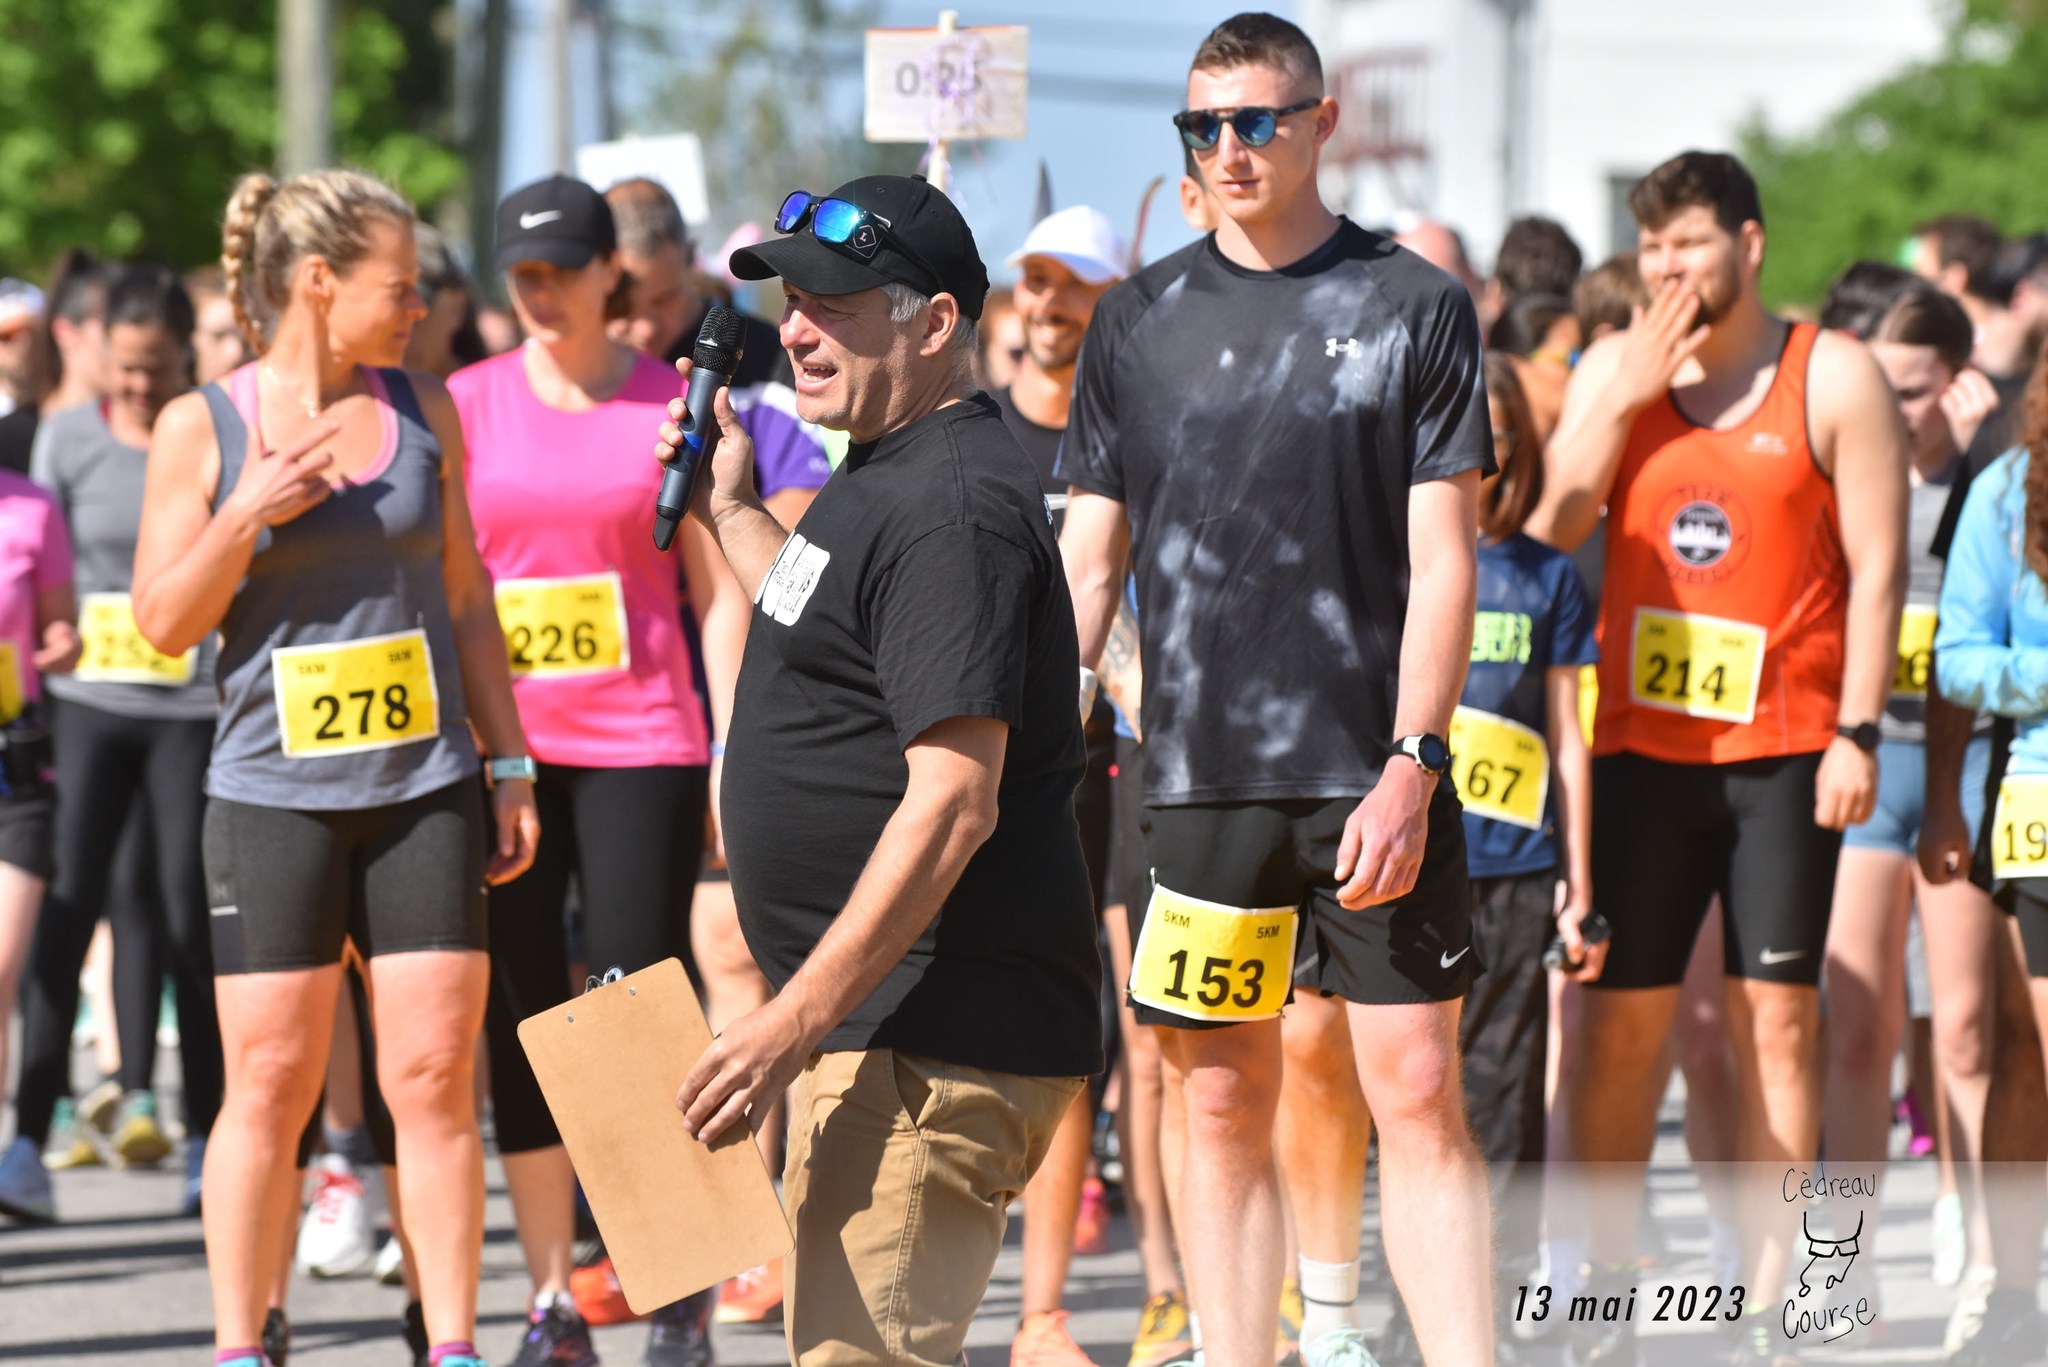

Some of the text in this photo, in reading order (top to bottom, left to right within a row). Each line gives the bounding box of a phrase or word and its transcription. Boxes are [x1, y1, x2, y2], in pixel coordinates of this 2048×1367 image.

[511, 622, 599, 664] 226
[1645, 653, 1725, 702] 214
[313, 684, 411, 741] 278
[1164, 910, 1191, 929] 5KM
[1256, 925, 1281, 940] 5KM
[1164, 949, 1265, 1009] 153
